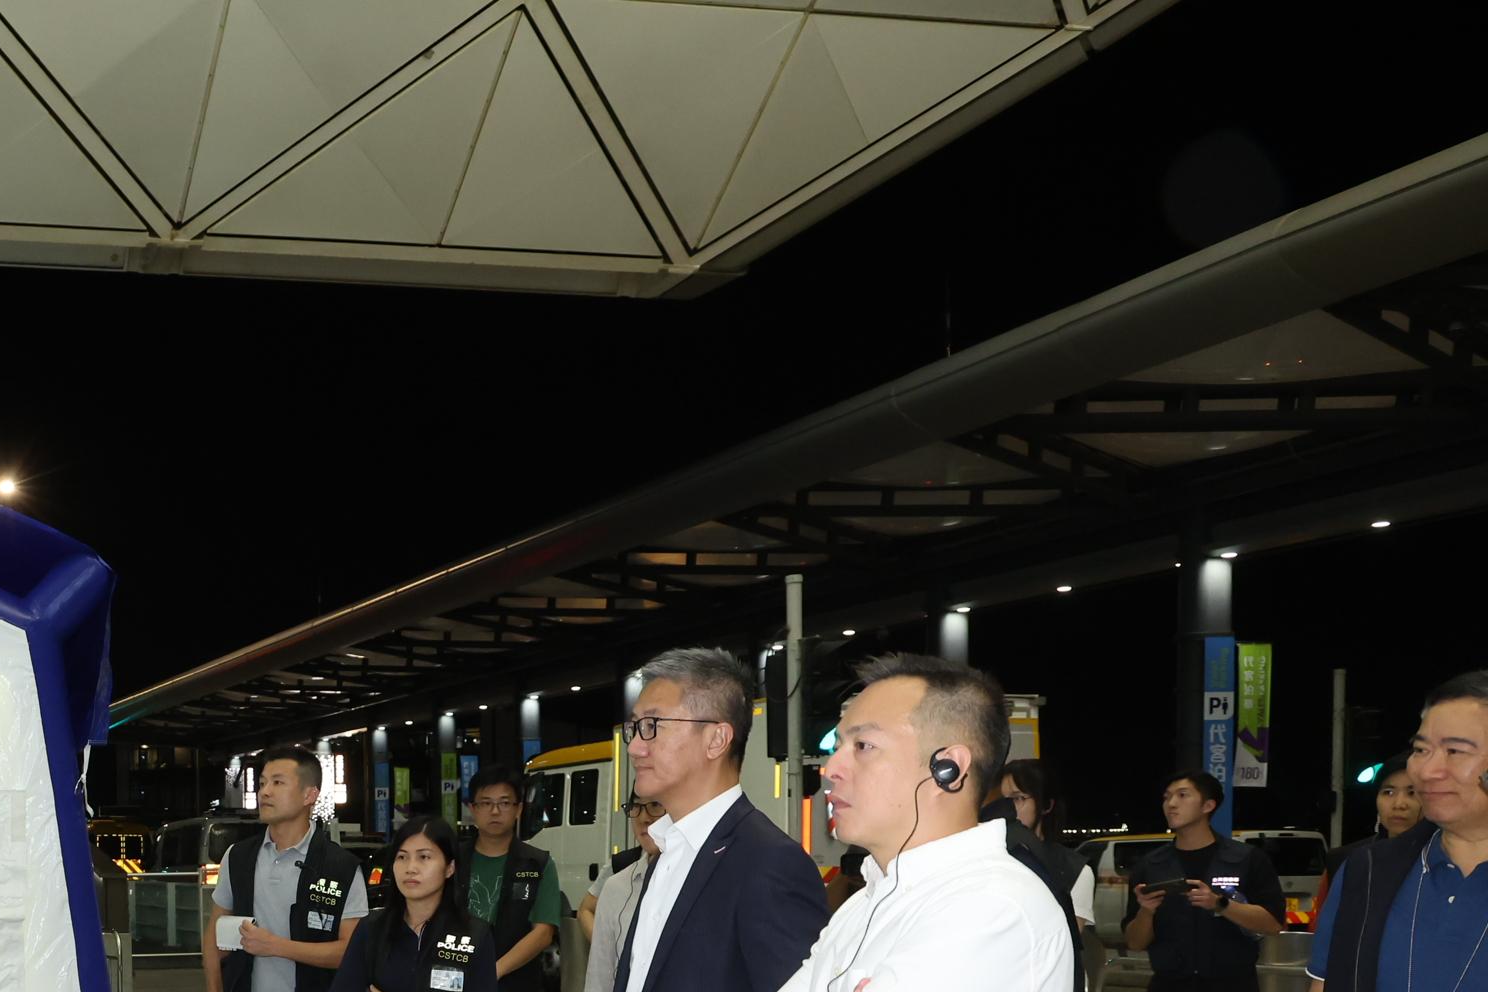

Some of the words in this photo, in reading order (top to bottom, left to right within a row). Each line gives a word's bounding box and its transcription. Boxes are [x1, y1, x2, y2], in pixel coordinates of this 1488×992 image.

[1209, 723, 1227, 783] 代客泊
[309, 883, 342, 898] POLICE
[309, 893, 337, 906] CSTCB
[437, 941, 475, 953] POLICE
[438, 950, 469, 963] CSTCB
